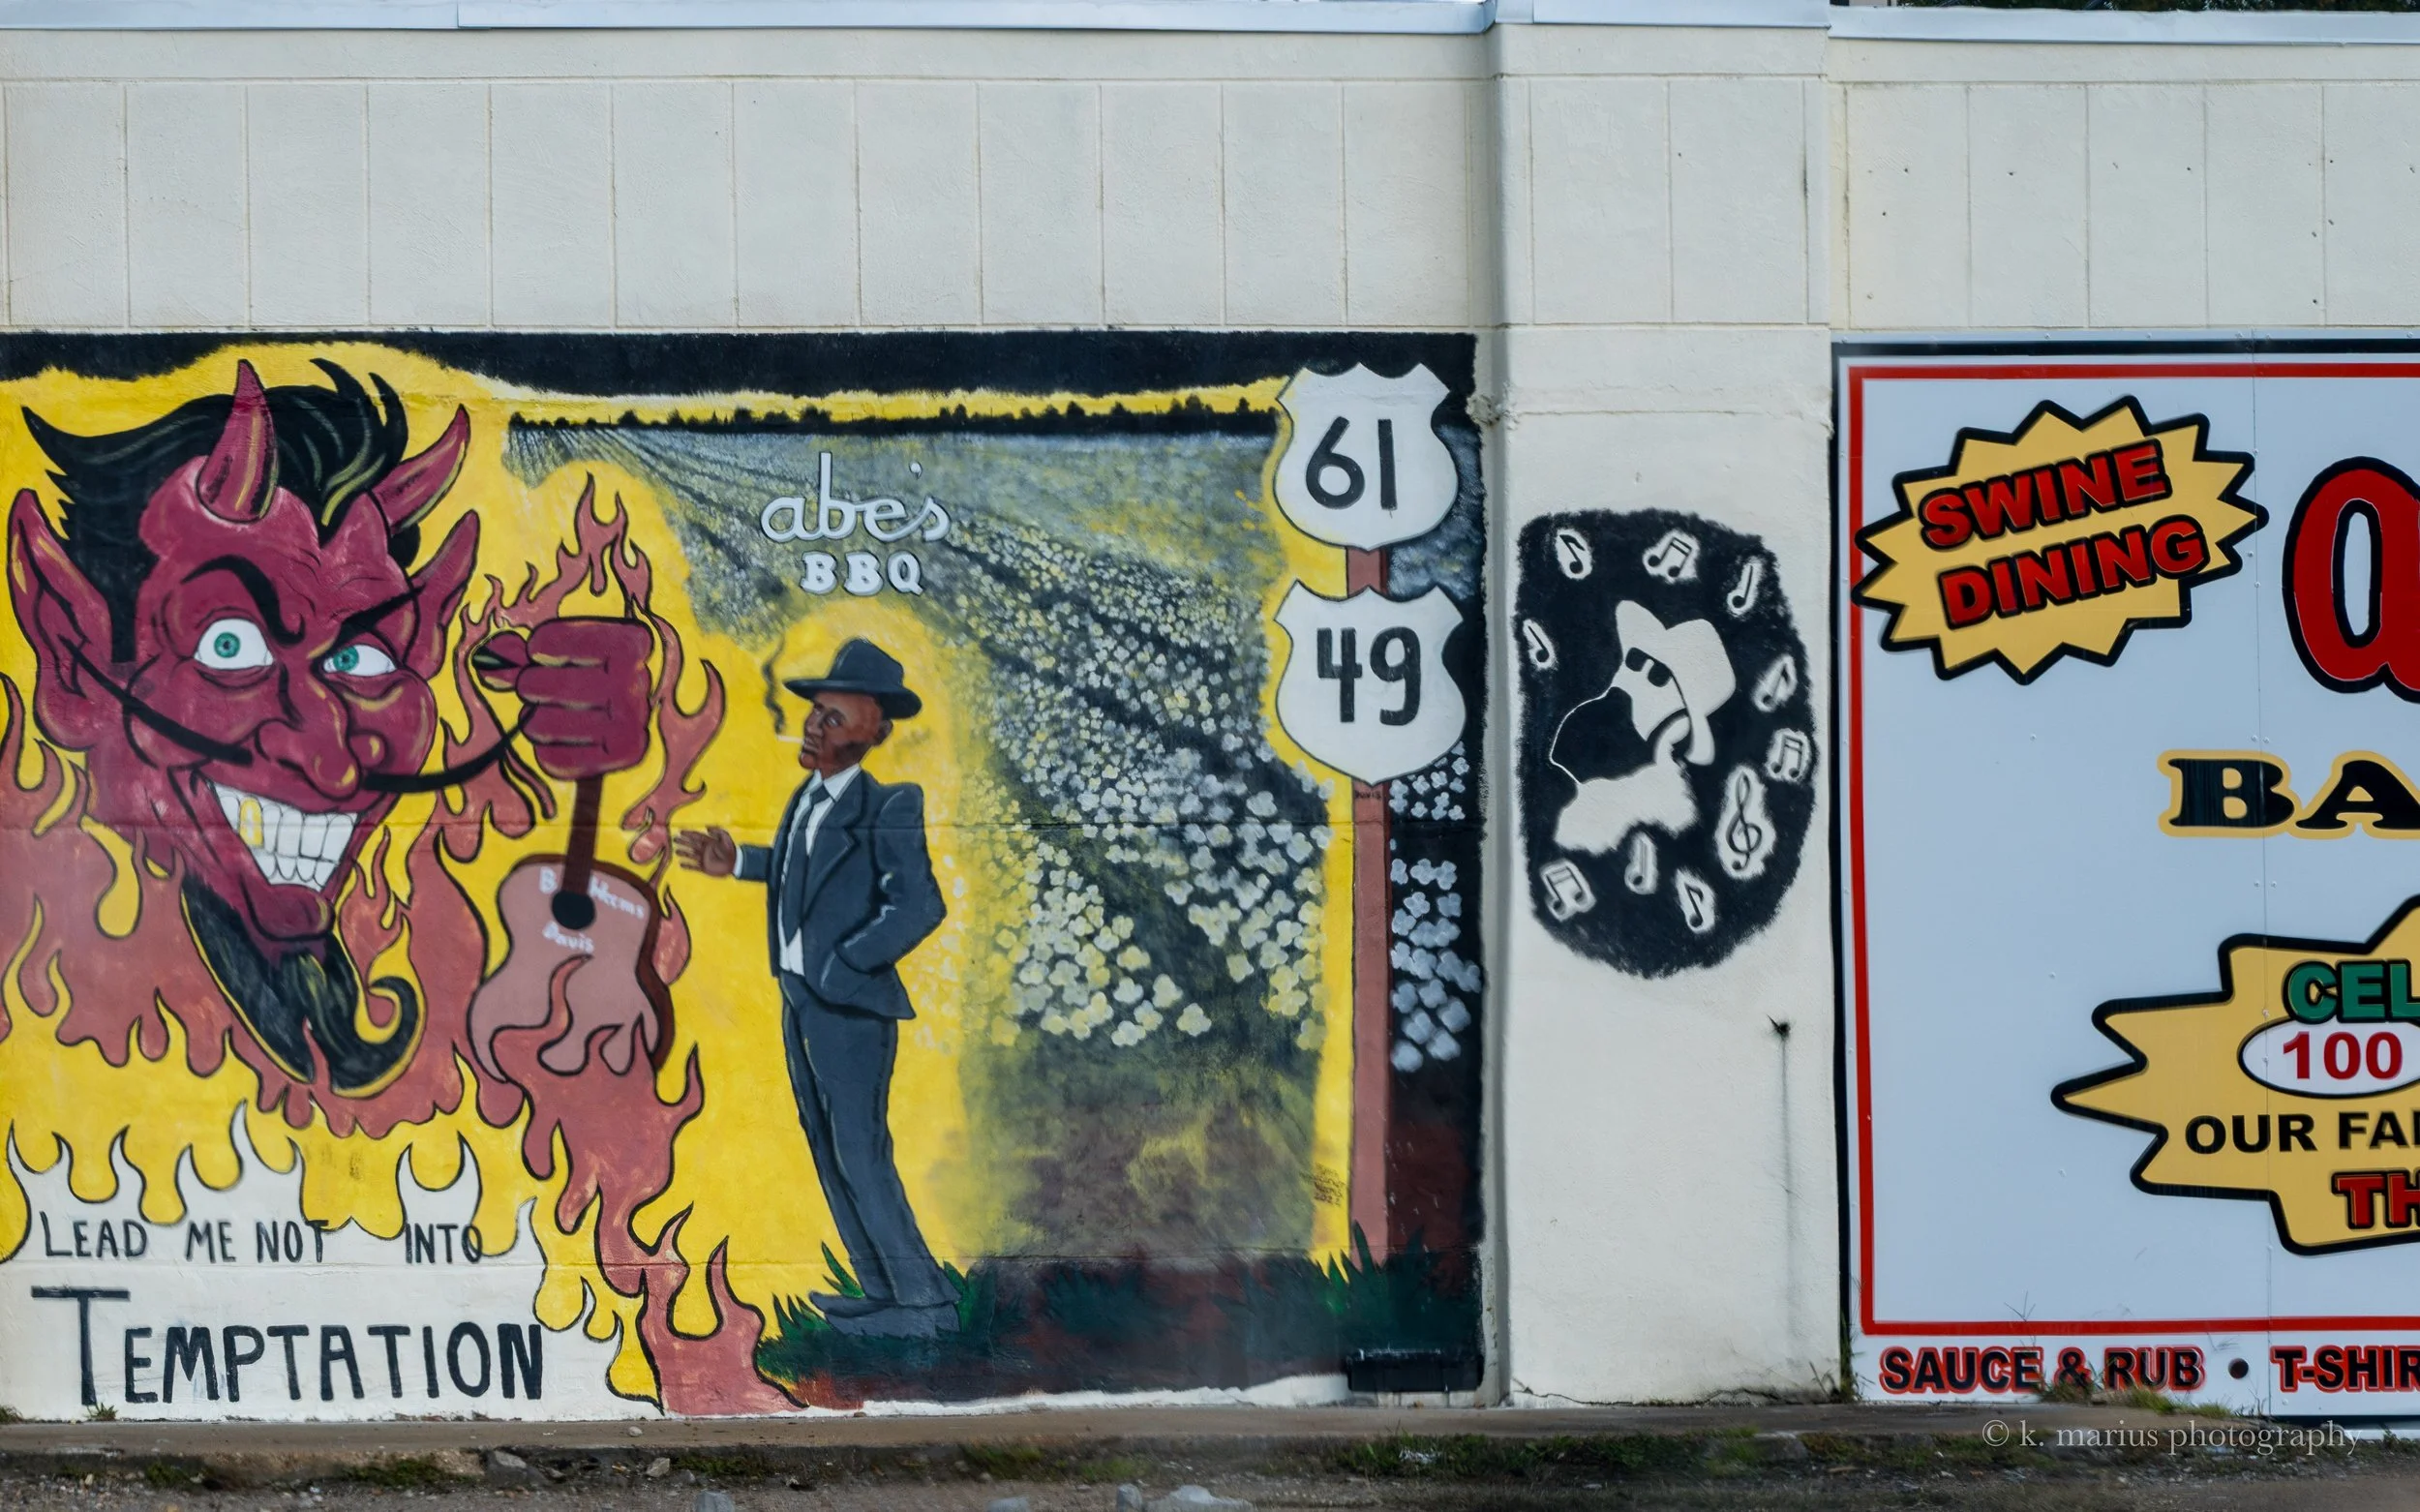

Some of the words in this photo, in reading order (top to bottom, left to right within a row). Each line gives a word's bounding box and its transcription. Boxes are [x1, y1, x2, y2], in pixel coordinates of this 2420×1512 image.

[760, 451, 952, 544] abe's
[1305, 415, 1398, 511] 61
[1919, 438, 2172, 550] SWINE
[800, 551, 923, 596] BBQ
[1936, 514, 2210, 629] DINING
[1316, 625, 1422, 727] 49
[539, 865, 558, 894] B
[2283, 1031, 2403, 1081] 100
[2185, 1114, 2318, 1155] OUR
[2339, 1110, 2420, 1150] FA
[40, 1210, 147, 1257] LEAD
[186, 1220, 236, 1262] ME
[256, 1220, 329, 1262] NOT
[405, 1223, 483, 1264] INTO
[31, 1285, 542, 1406] TEMPTATION
[1880, 1346, 2044, 1394] SAUCE
[2053, 1346, 2093, 1392] &
[2103, 1345, 2204, 1391] RUB
